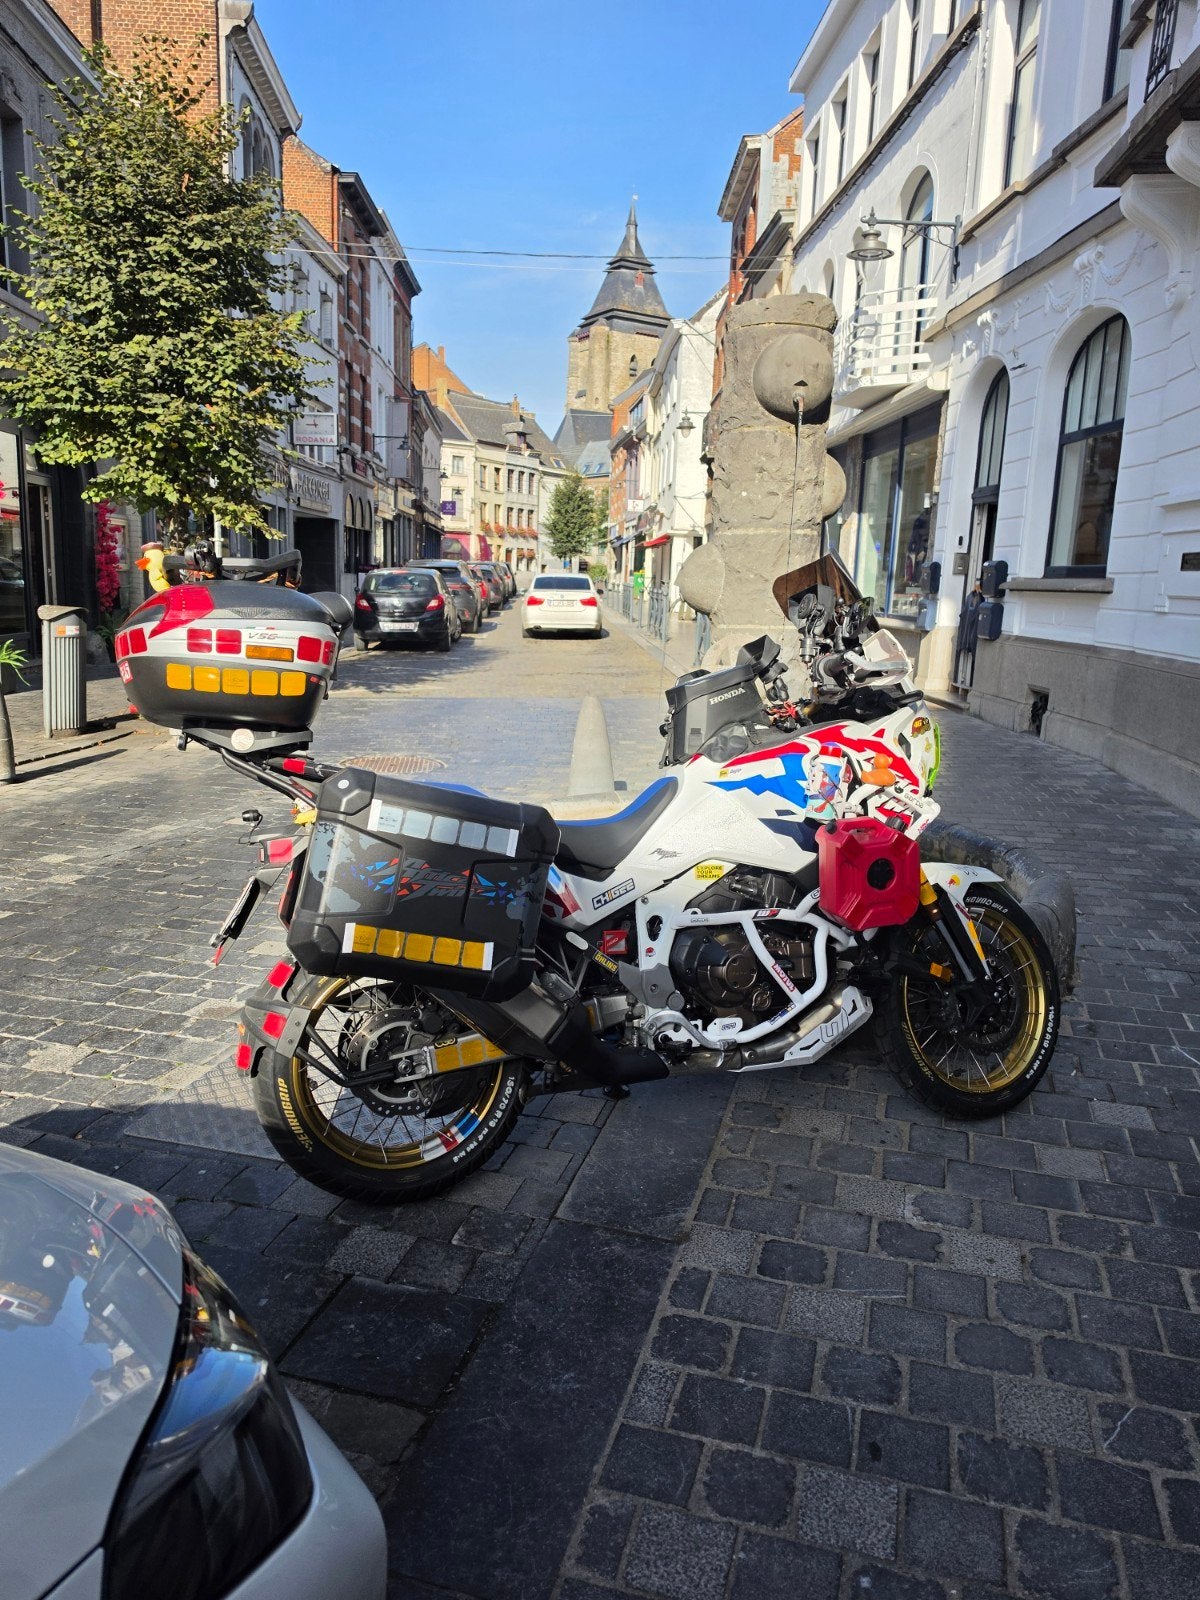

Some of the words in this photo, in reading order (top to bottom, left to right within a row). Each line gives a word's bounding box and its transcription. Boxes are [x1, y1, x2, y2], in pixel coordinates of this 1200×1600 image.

[709, 687, 746, 705] HONDA
[593, 879, 635, 908] CHIGEE
[771, 963, 796, 992] MOTUL
[499, 1076, 515, 1110] 150/70
[277, 1077, 310, 1142] EUROGRIP
